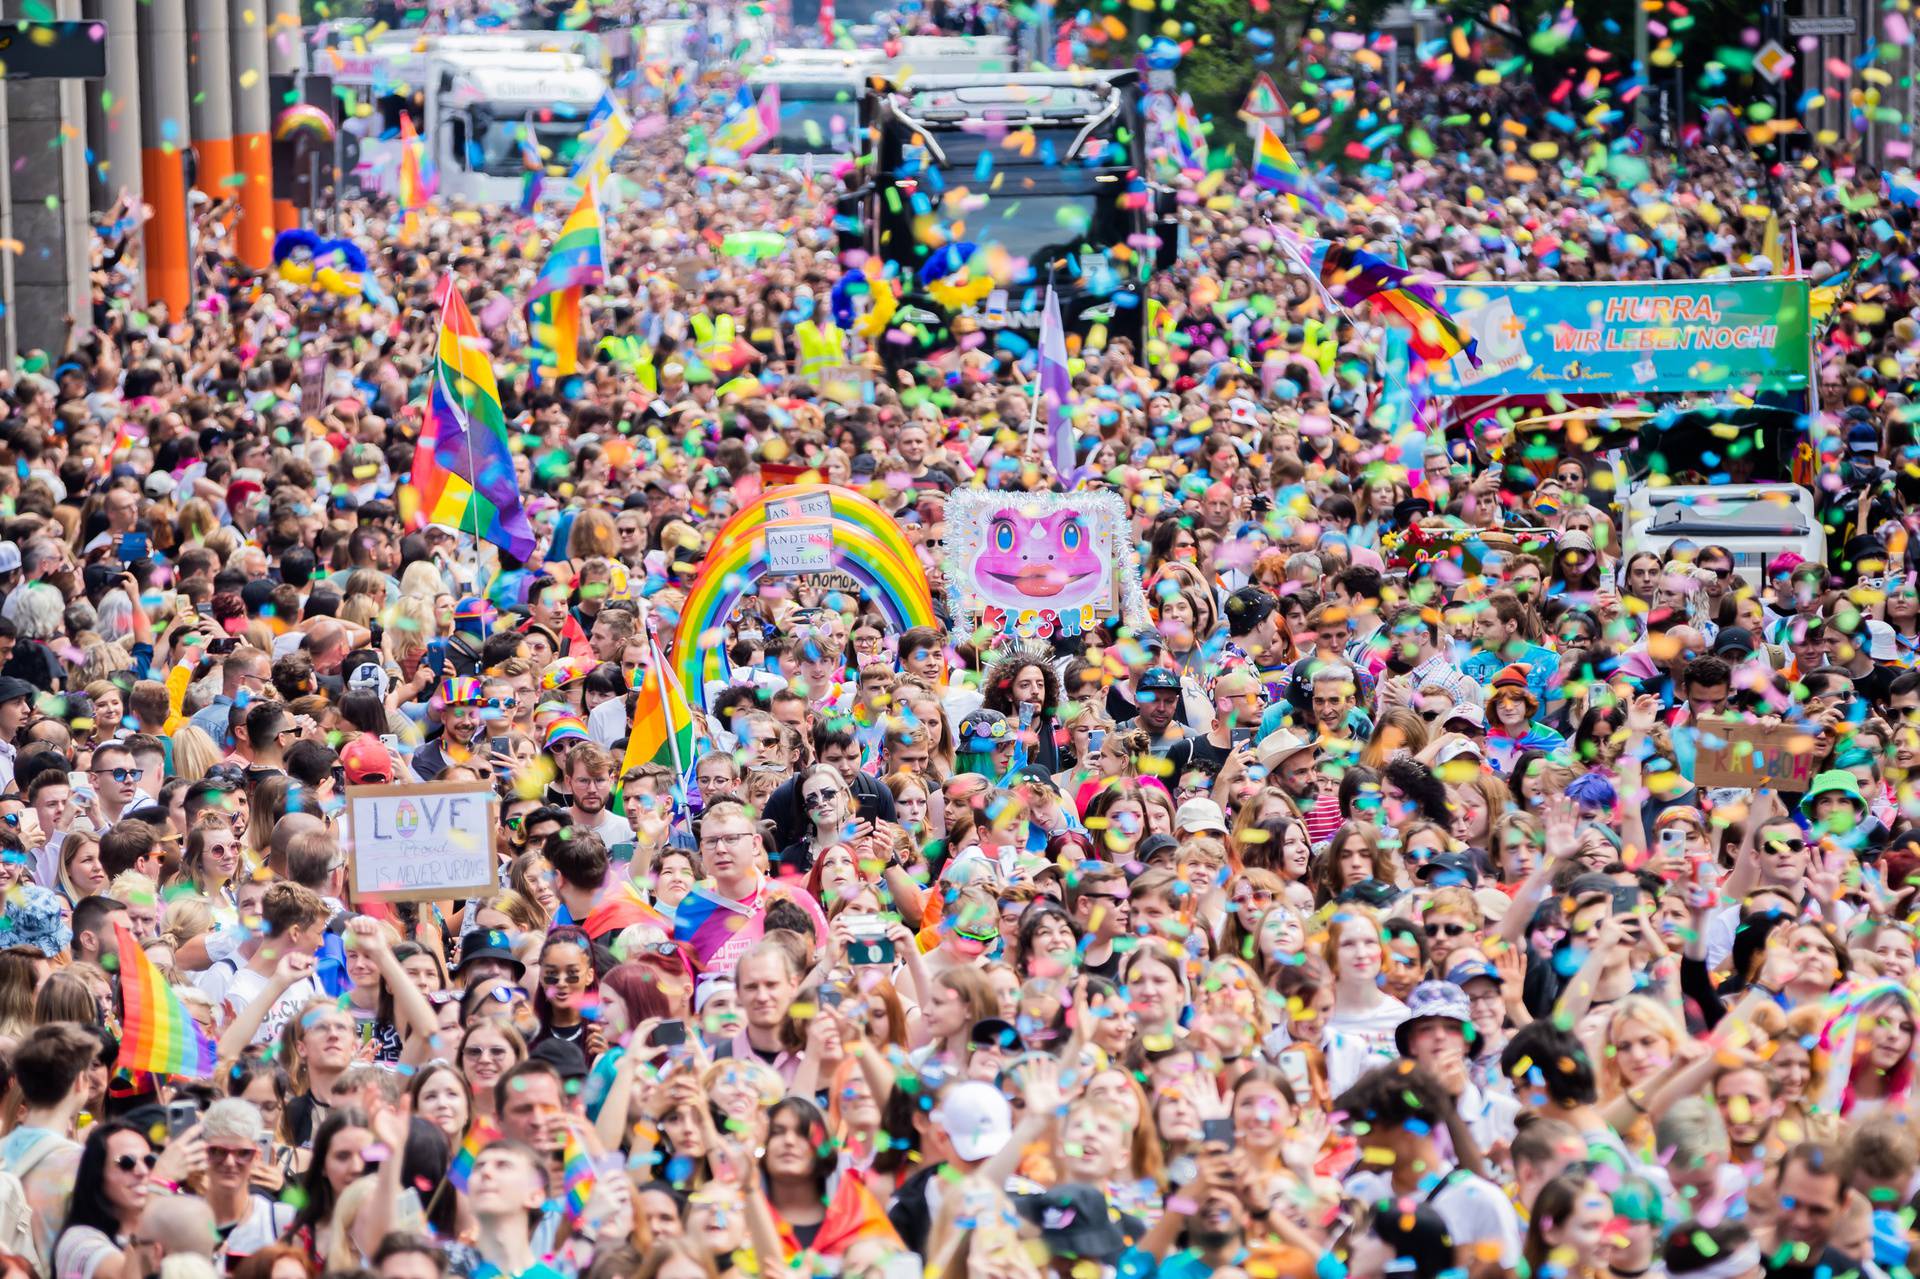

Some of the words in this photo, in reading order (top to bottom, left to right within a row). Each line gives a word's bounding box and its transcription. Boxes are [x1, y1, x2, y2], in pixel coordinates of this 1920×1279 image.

[1605, 294, 1722, 325] HURRA,
[1553, 328, 1601, 352] WIR
[1605, 327, 1692, 352] LEBEN
[1694, 325, 1778, 349] NOCH!
[772, 501, 829, 519] ANERS?
[770, 532, 829, 545] ANDERS?
[373, 797, 471, 840] LOVE
[398, 861, 442, 885] NEVER
